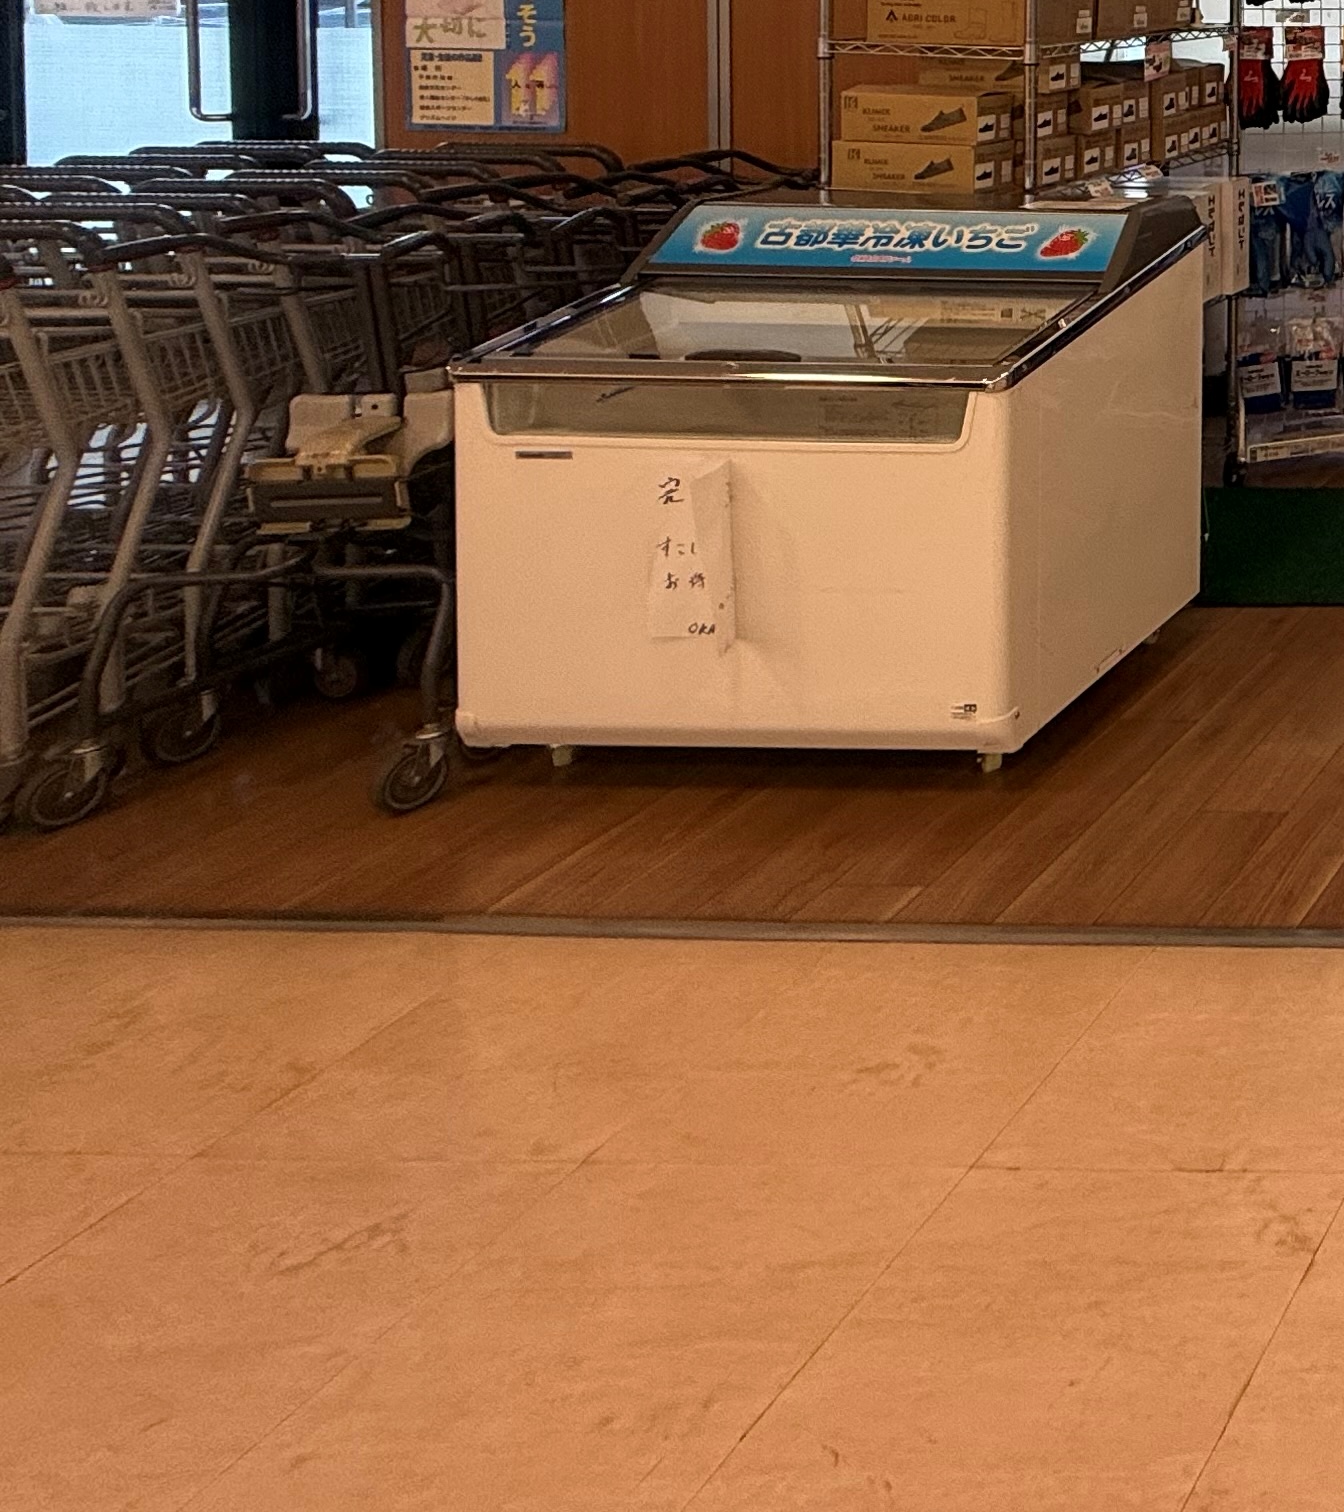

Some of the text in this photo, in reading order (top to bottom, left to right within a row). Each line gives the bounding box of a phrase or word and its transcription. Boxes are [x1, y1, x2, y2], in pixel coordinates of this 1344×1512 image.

[412, 17, 487, 44] 大切に
[759, 218, 1037, 251] 古都華冷凍いちご
